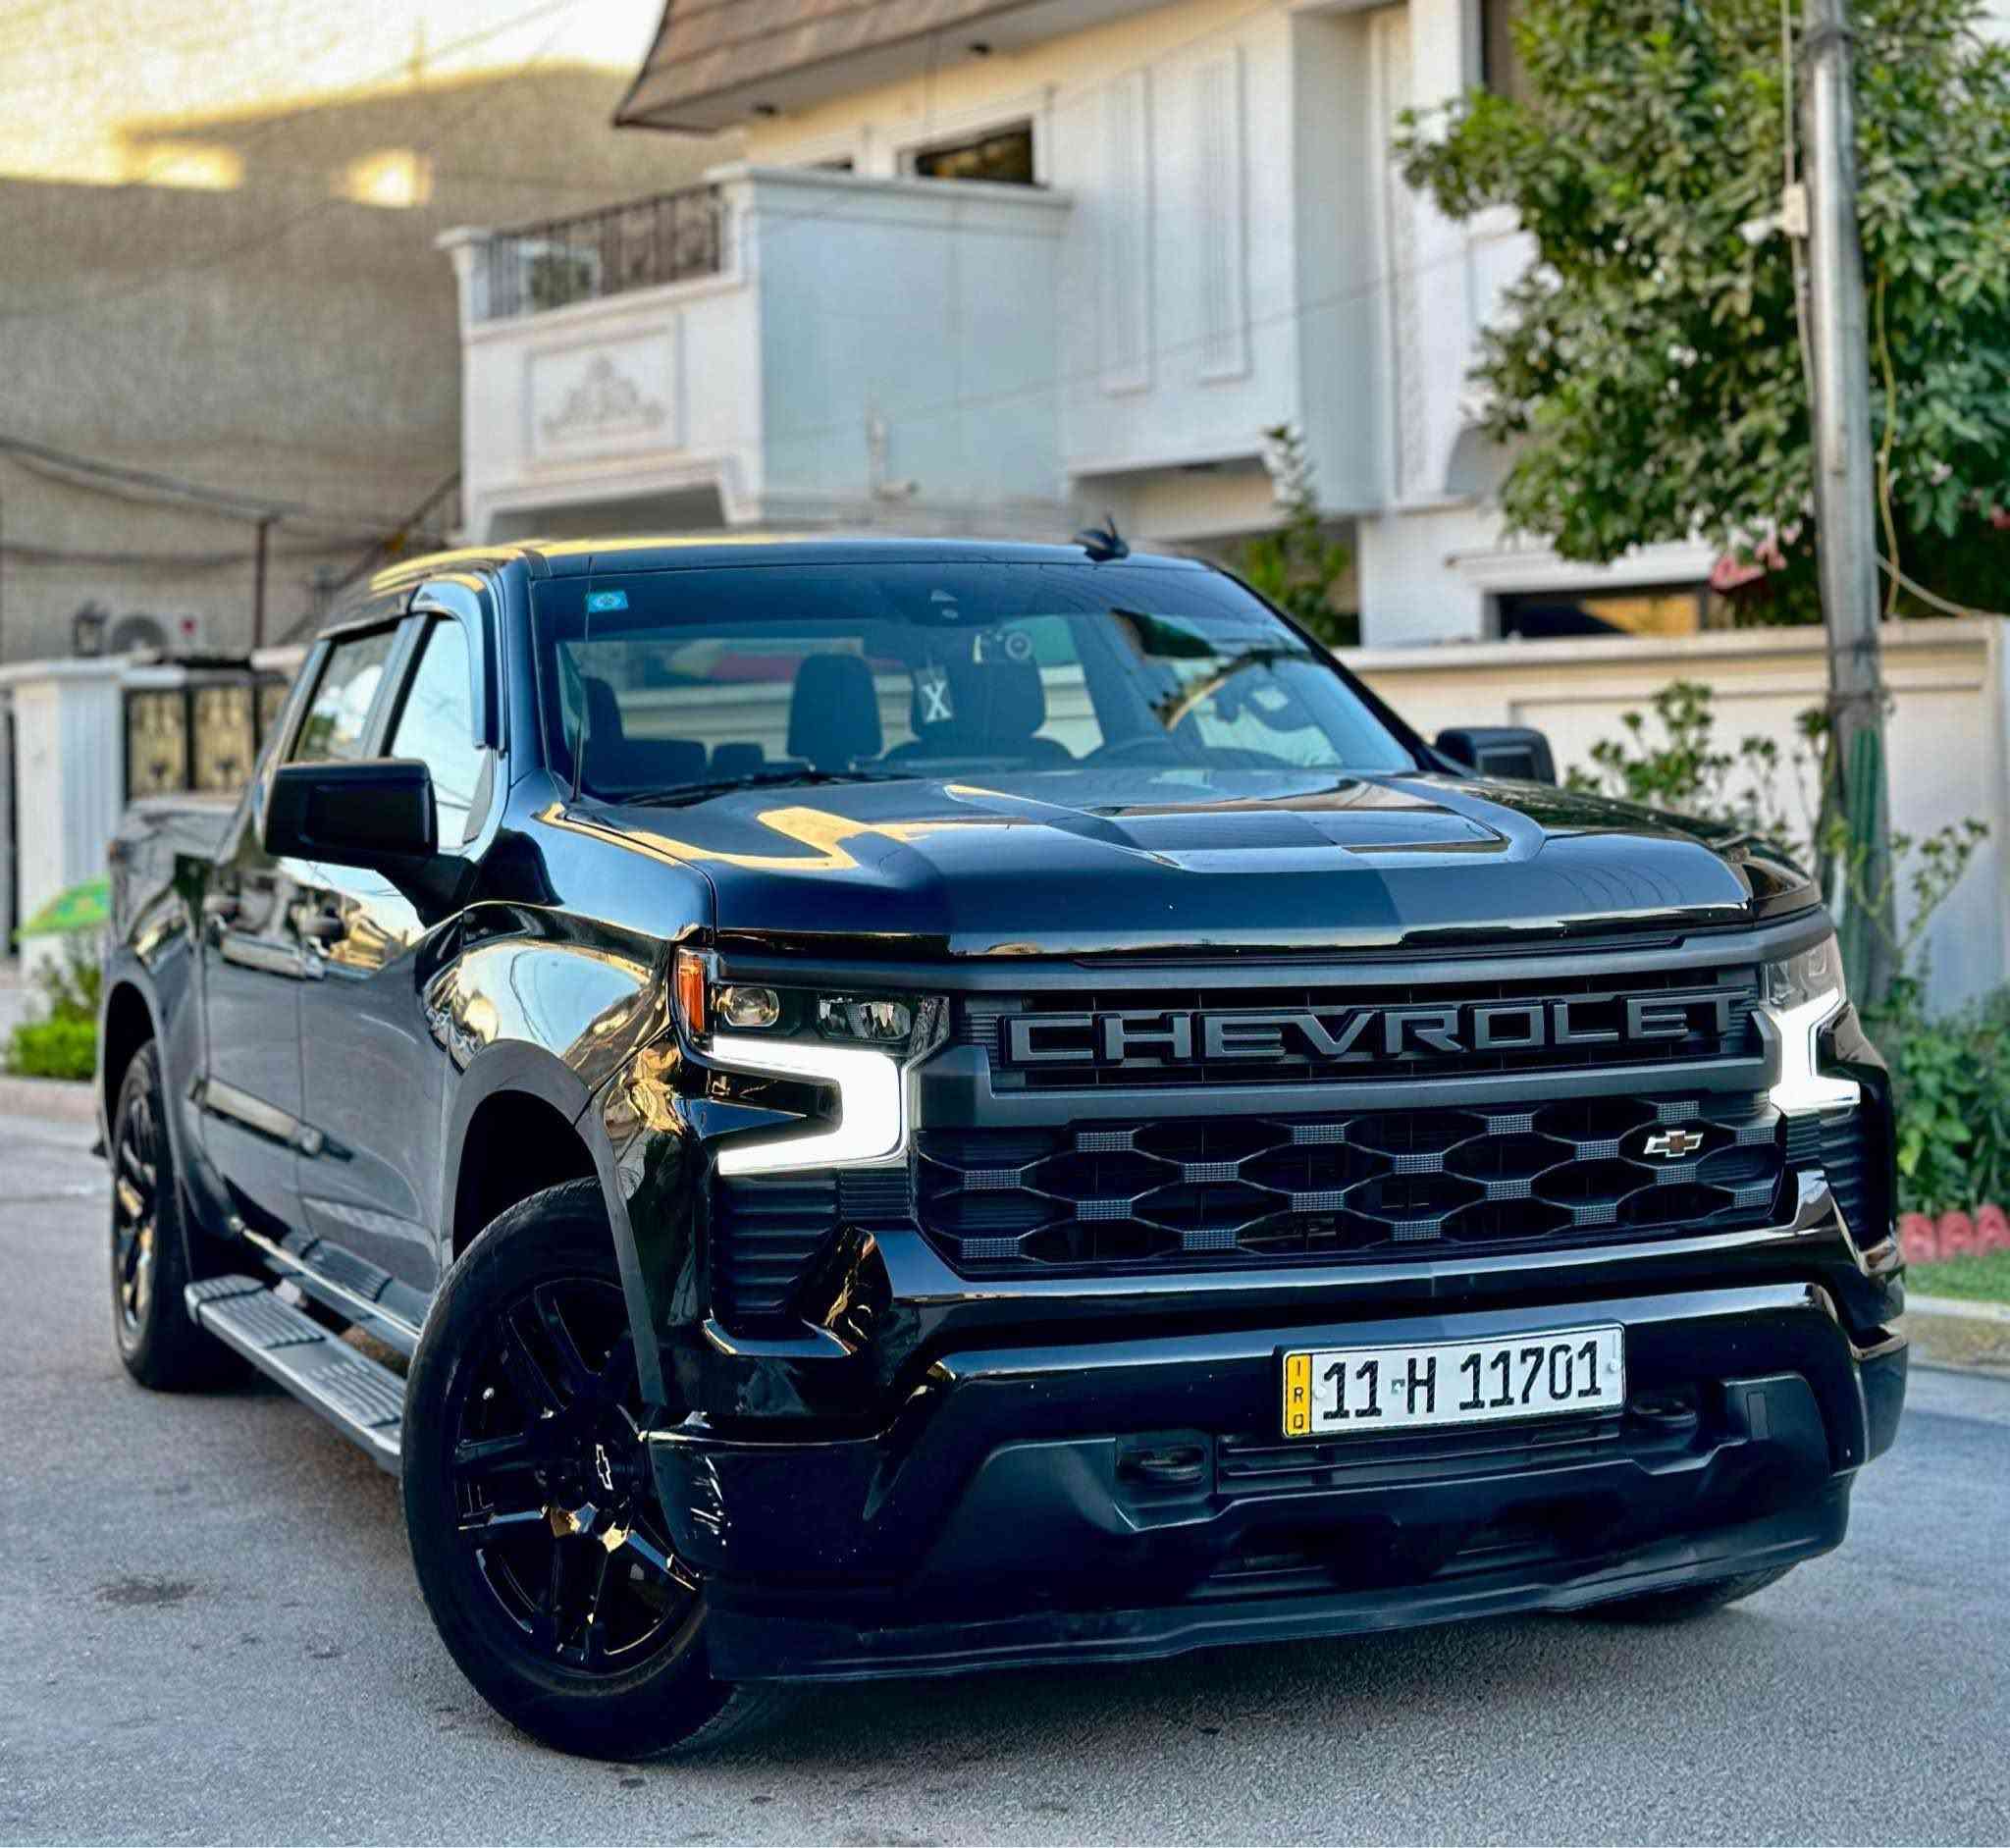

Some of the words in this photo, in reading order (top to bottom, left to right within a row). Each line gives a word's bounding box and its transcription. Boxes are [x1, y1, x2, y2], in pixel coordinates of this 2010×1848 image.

[1008, 989, 1750, 1064] CHEVROLET
[1323, 1360, 1382, 1420] 11
[1406, 1356, 1437, 1414] H
[1458, 1340, 1603, 1411] 11701
